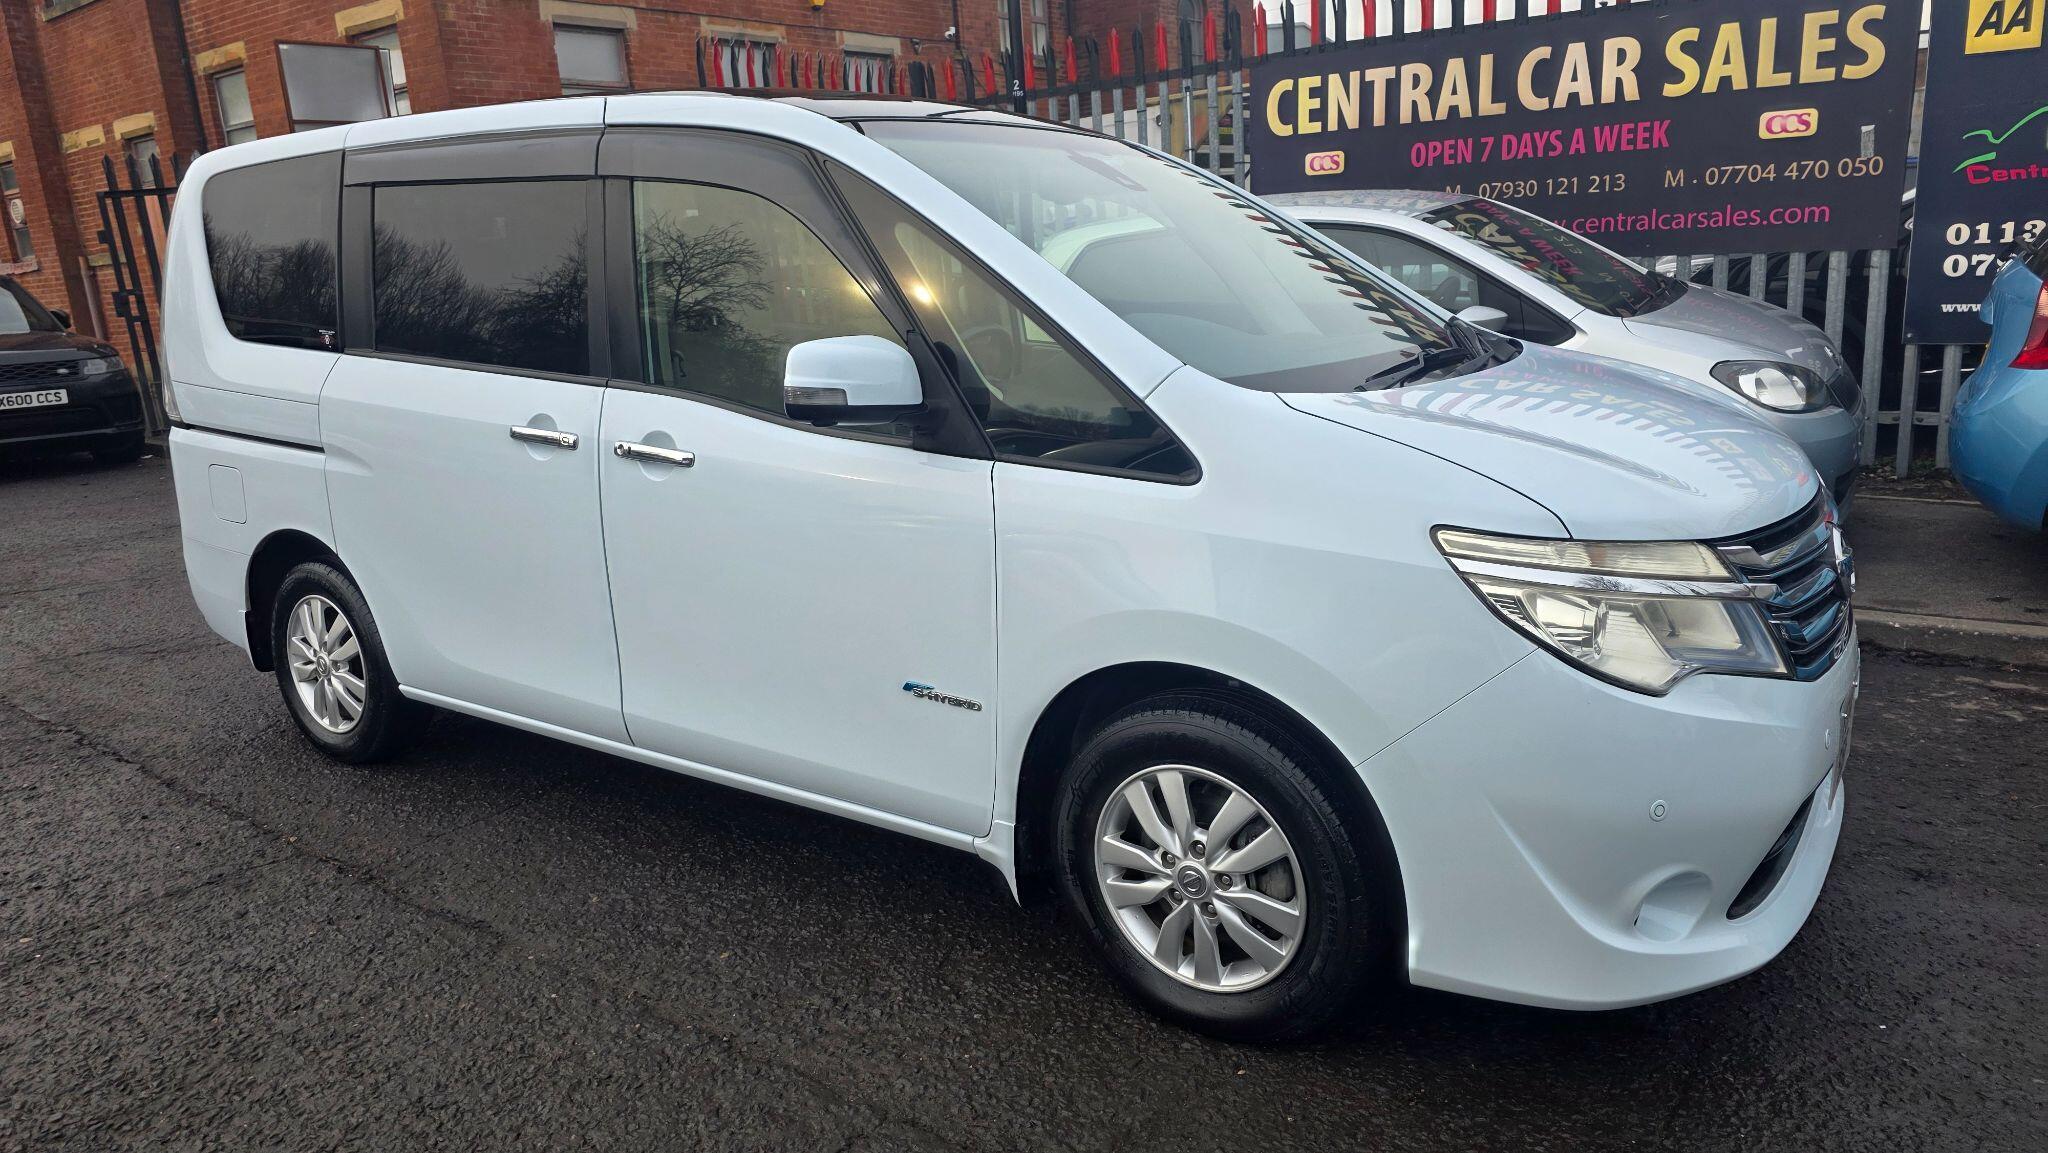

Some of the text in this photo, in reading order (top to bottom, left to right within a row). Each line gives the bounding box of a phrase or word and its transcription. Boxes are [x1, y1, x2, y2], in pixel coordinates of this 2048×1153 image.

[1974, 0, 2034, 37] AA
[1266, 4, 1886, 137] CENTRAL CAR SALES
[1013, 80, 1020, 90] 2
[1765, 112, 1812, 135] CCS
[1411, 120, 1671, 168] OPEN 7 DAYS A WEEK
[1309, 154, 1340, 172] CCS
[1705, 163, 1777, 186] 07704
[1783, 159, 1830, 180] 470
[1837, 155, 1884, 177] 050
[1478, 180, 1538, 200] 07930
[1545, 177, 1578, 195] 121
[1588, 173, 1626, 192] 213
[36, 391, 62, 404] CCS
